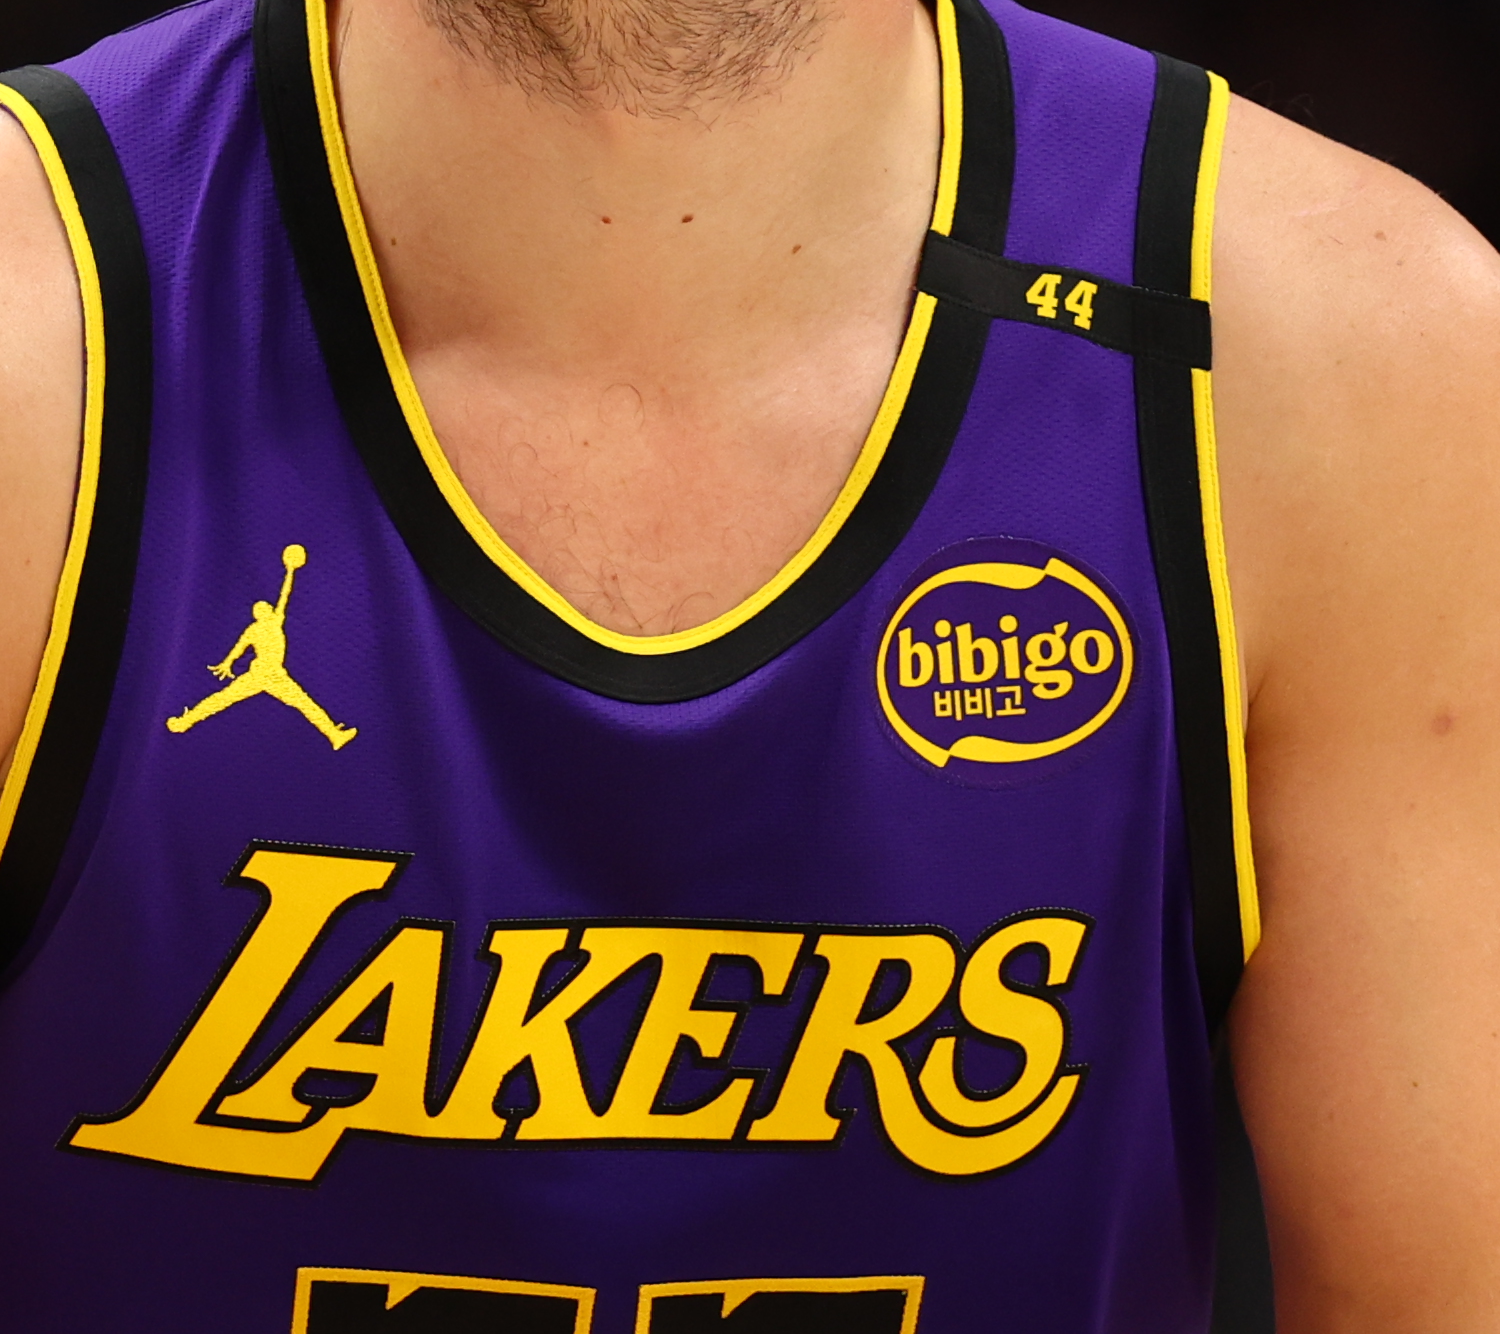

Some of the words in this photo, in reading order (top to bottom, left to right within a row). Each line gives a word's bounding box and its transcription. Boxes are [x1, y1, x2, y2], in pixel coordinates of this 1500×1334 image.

[1025, 273, 1098, 330] 44
[898, 614, 1115, 700] bibigo
[933, 685, 1026, 721] 비비고
[58, 839, 1095, 1187] LAKERS
